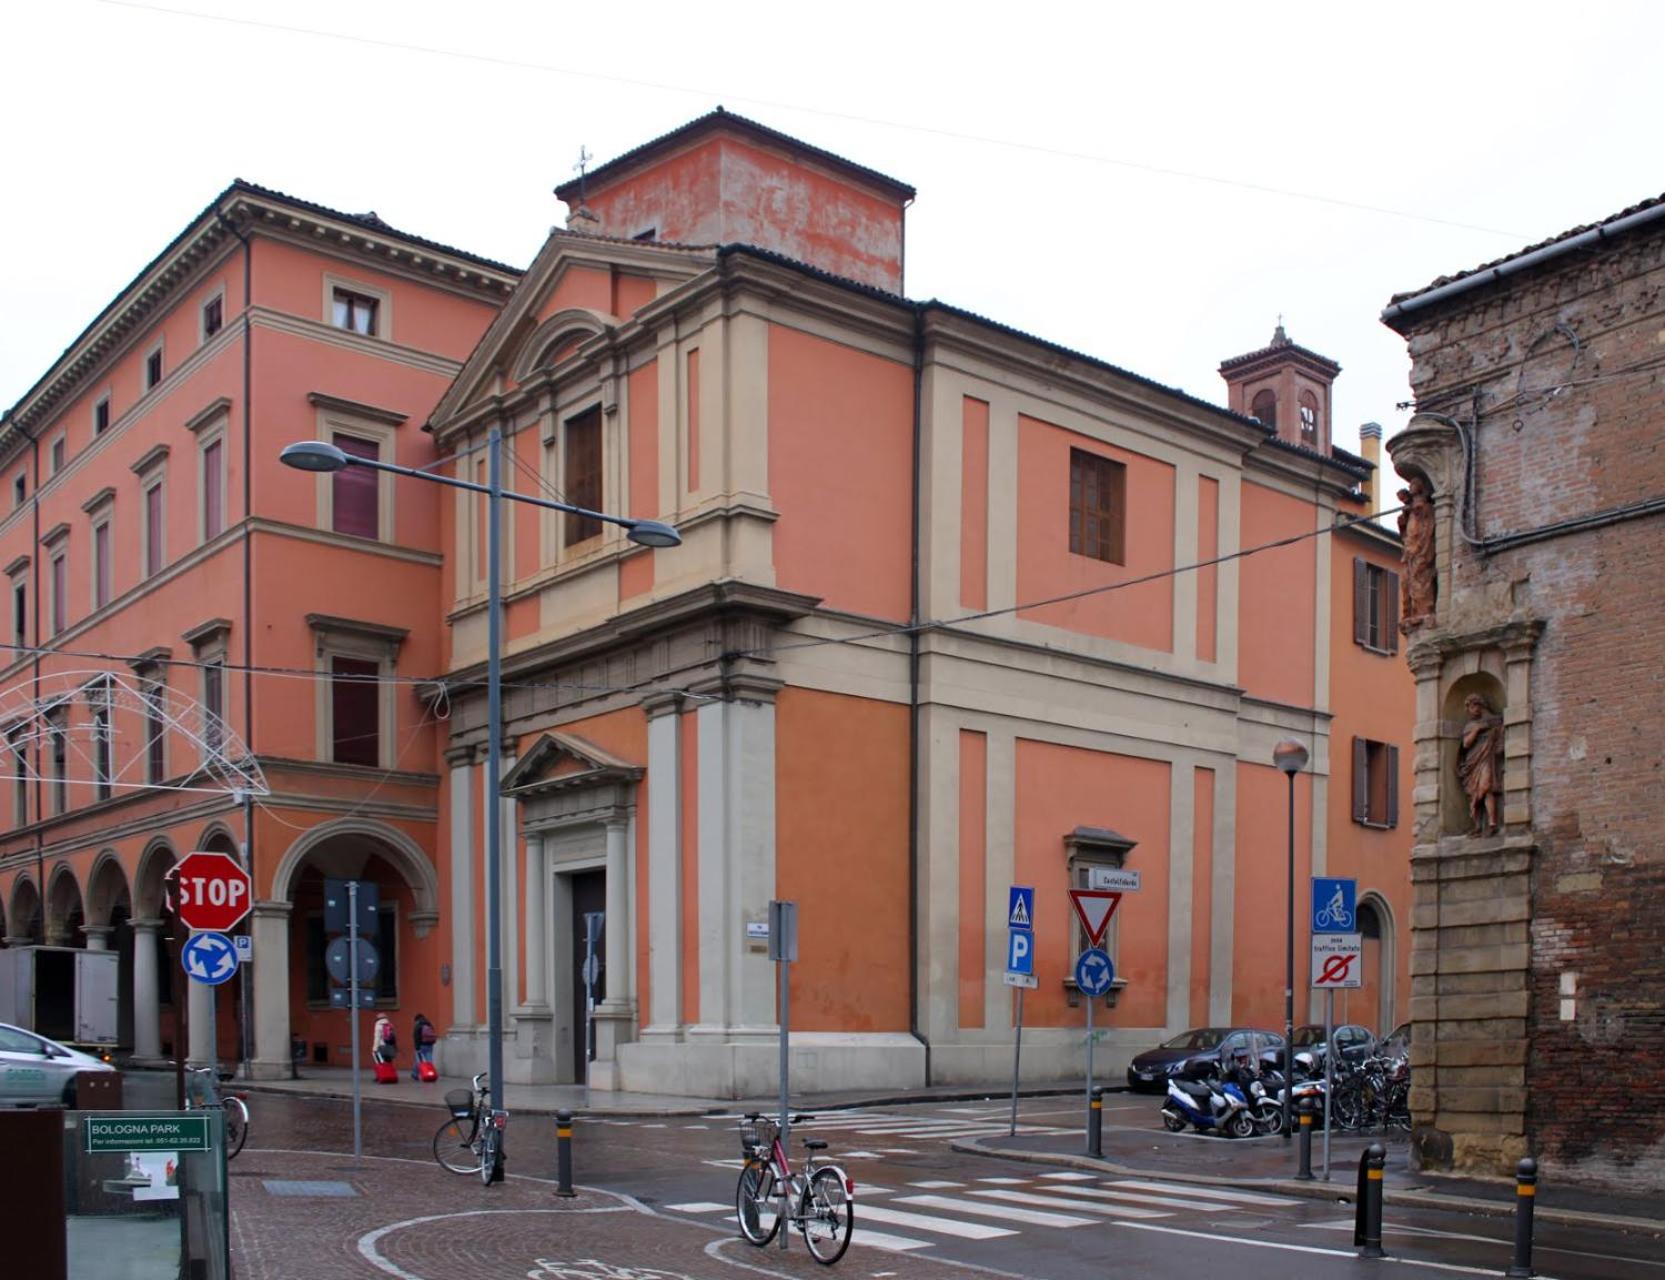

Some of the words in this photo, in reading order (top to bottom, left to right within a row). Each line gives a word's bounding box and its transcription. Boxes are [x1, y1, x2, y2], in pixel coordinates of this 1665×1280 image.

[180, 877, 246, 907] STOP
[239, 938, 247, 947] P
[1012, 935, 1028, 967] P
[92, 1124, 149, 1135] BOLOGNA
[150, 1124, 181, 1134] PARK
